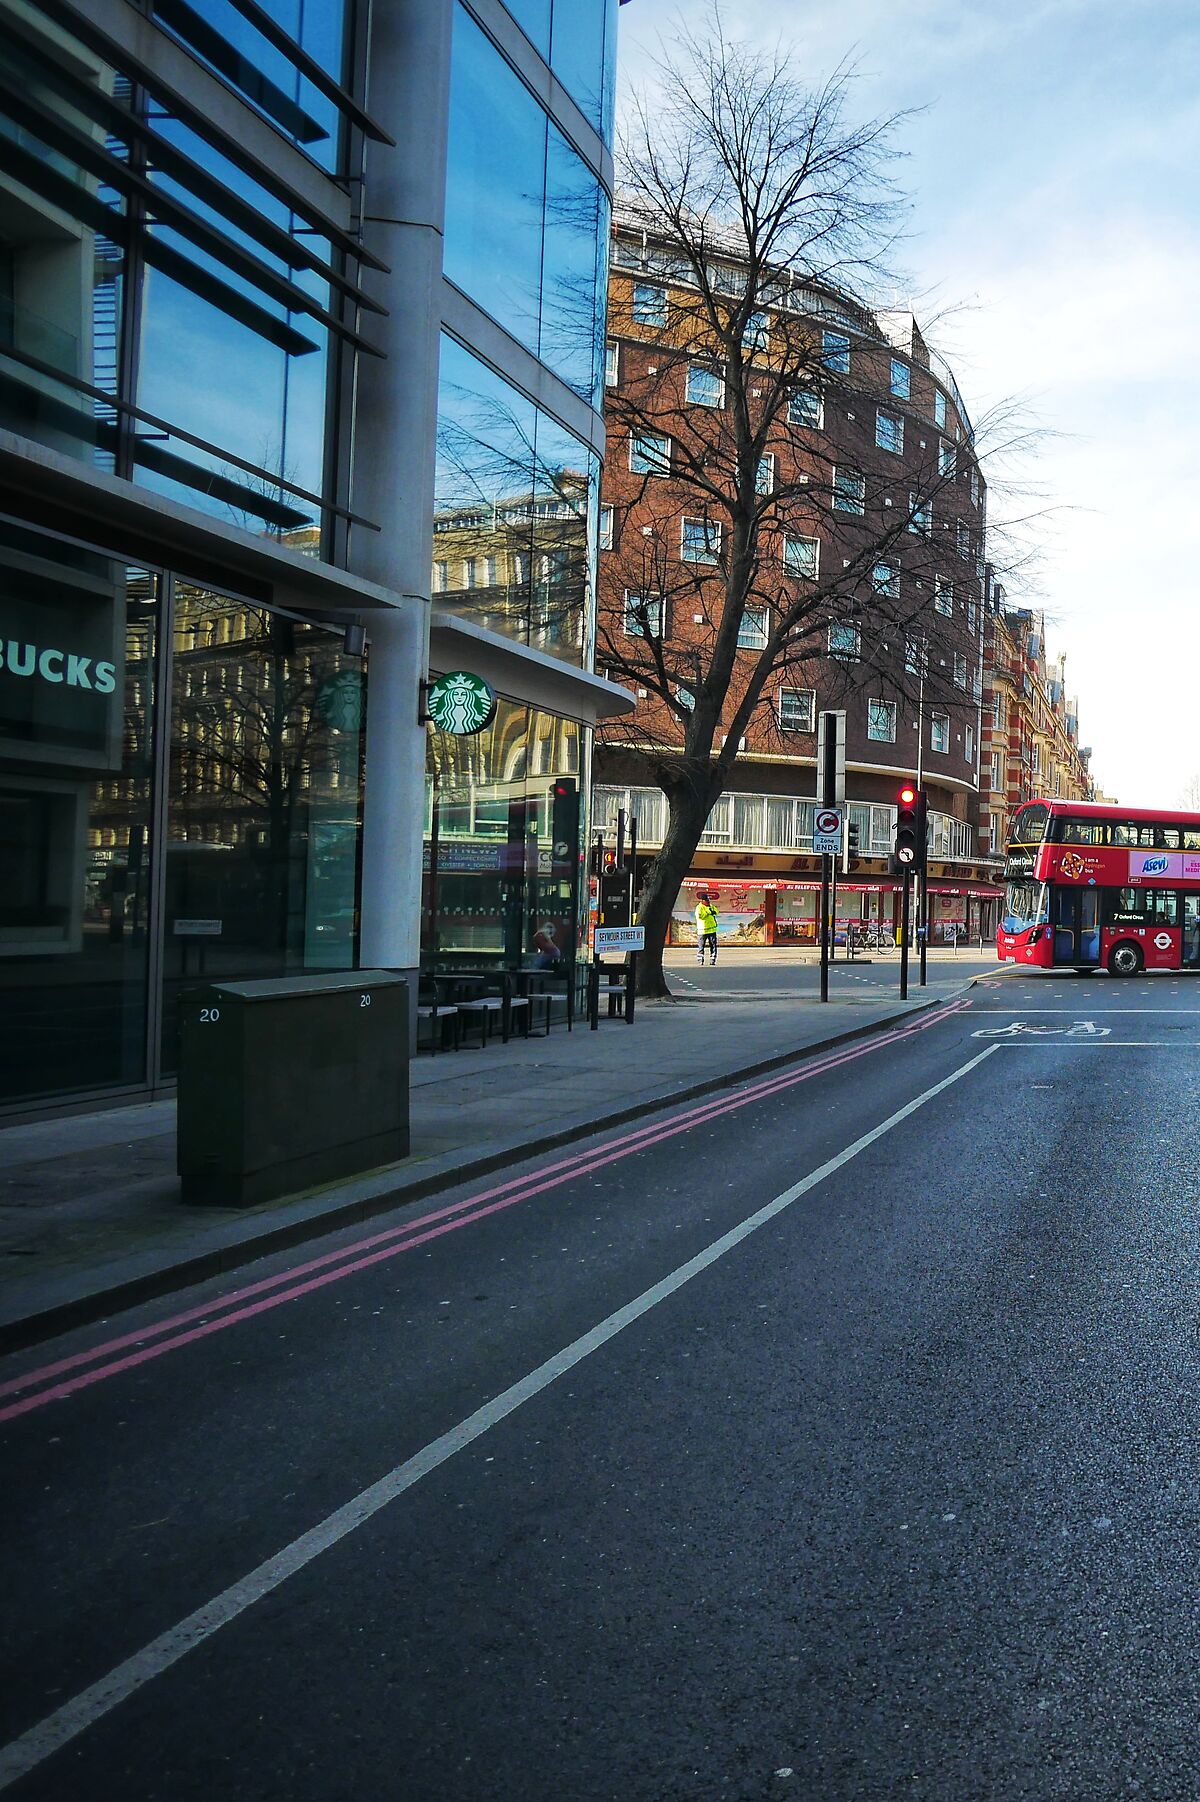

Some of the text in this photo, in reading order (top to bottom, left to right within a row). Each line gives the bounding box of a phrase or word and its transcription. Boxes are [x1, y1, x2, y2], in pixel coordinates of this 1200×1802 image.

[0, 639, 116, 693] UCKS
[1032, 854, 1038, 867] 7
[1142, 857, 1166, 873] Asevi
[599, 932, 620, 942] SEYMOUR
[620, 930, 636, 941] STREET
[360, 995, 371, 1007] 20
[200, 1008, 220, 1022] 20
